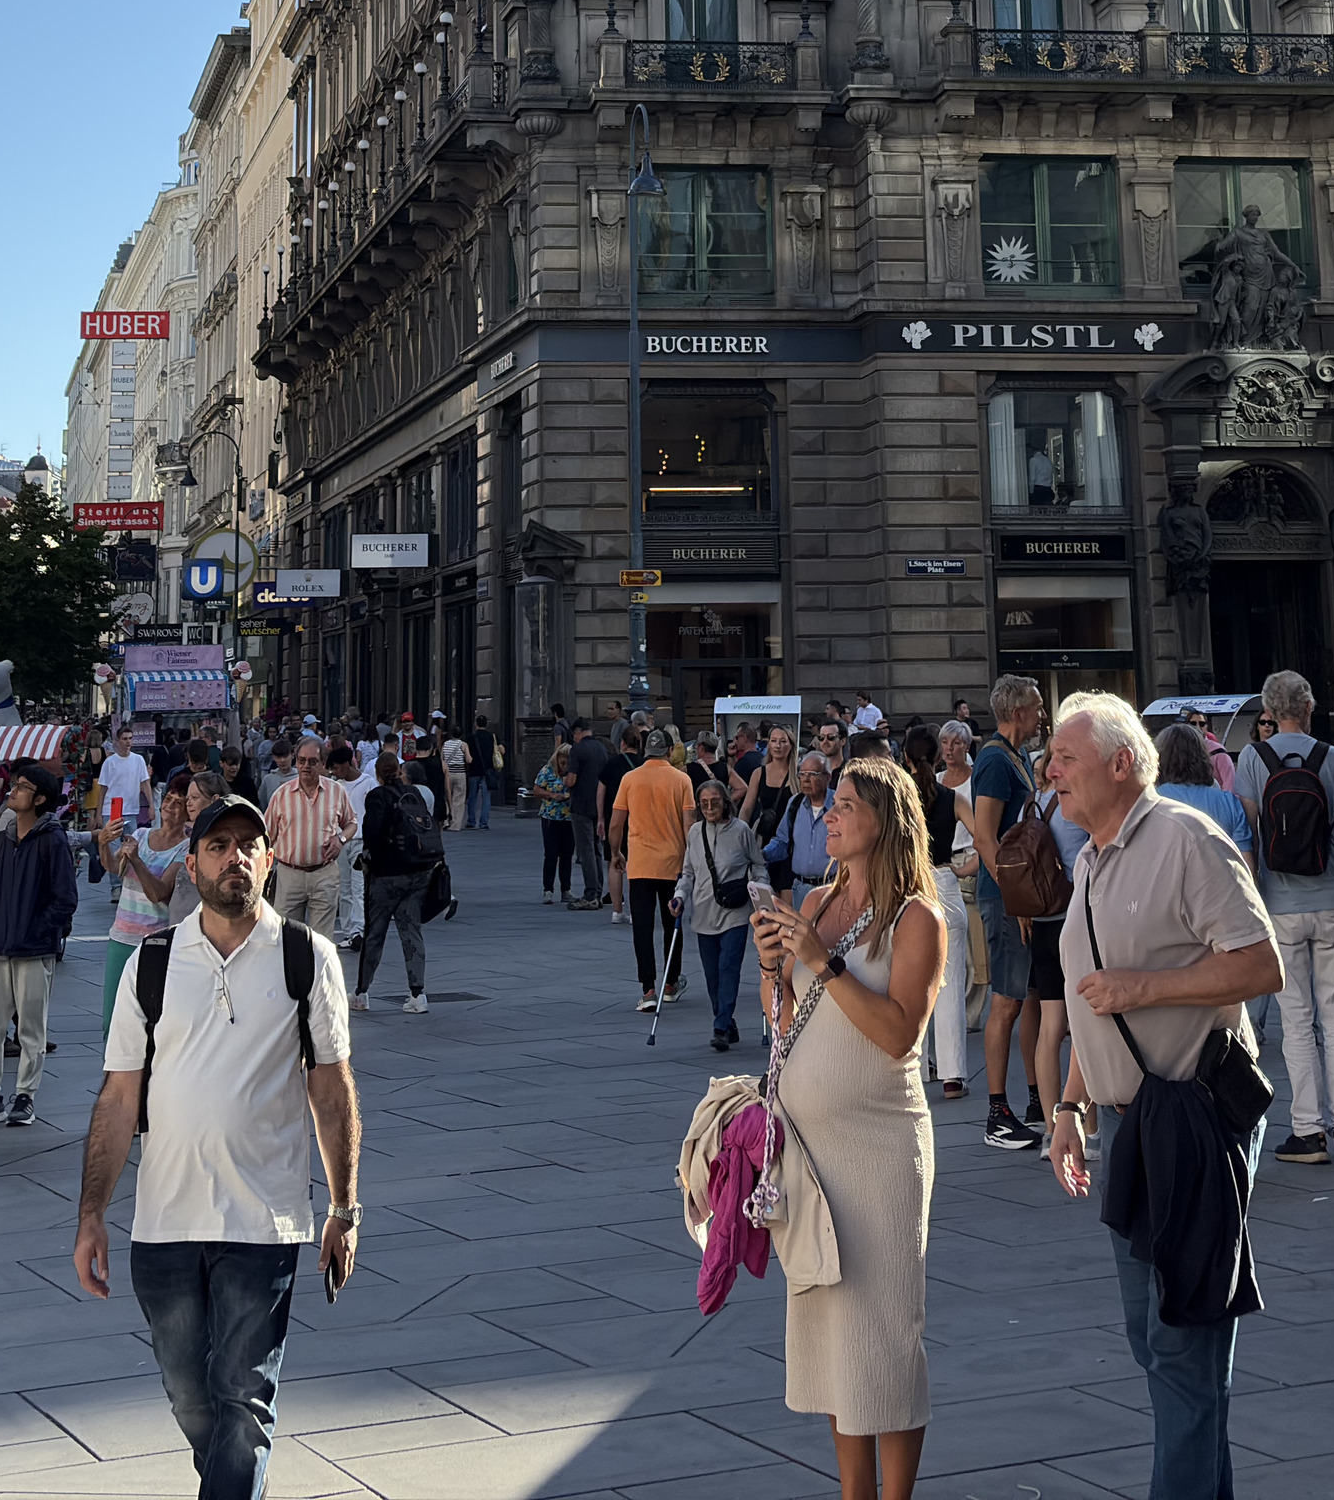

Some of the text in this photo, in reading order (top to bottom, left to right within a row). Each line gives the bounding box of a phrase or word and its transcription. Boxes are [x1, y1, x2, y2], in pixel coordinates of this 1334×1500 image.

[950, 323, 1115, 348] PILSTL
[646, 335, 769, 353] BUCHERER
[490, 351, 513, 380] BUCHERER
[1225, 422, 1314, 439] EQUITABLE
[78, 507, 159, 516] Steffl und
[152, 517, 159, 525] 5
[362, 543, 418, 552] BUCHERER
[1025, 542, 1101, 554] BUCHERER
[672, 549, 747, 560] BUCHERER
[190, 566, 218, 594] U
[137, 628, 183, 638] SWAROVSK
[188, 628, 202, 639] WC
[240, 626, 281, 636] wutscher
[679, 626, 704, 635] PATEK
